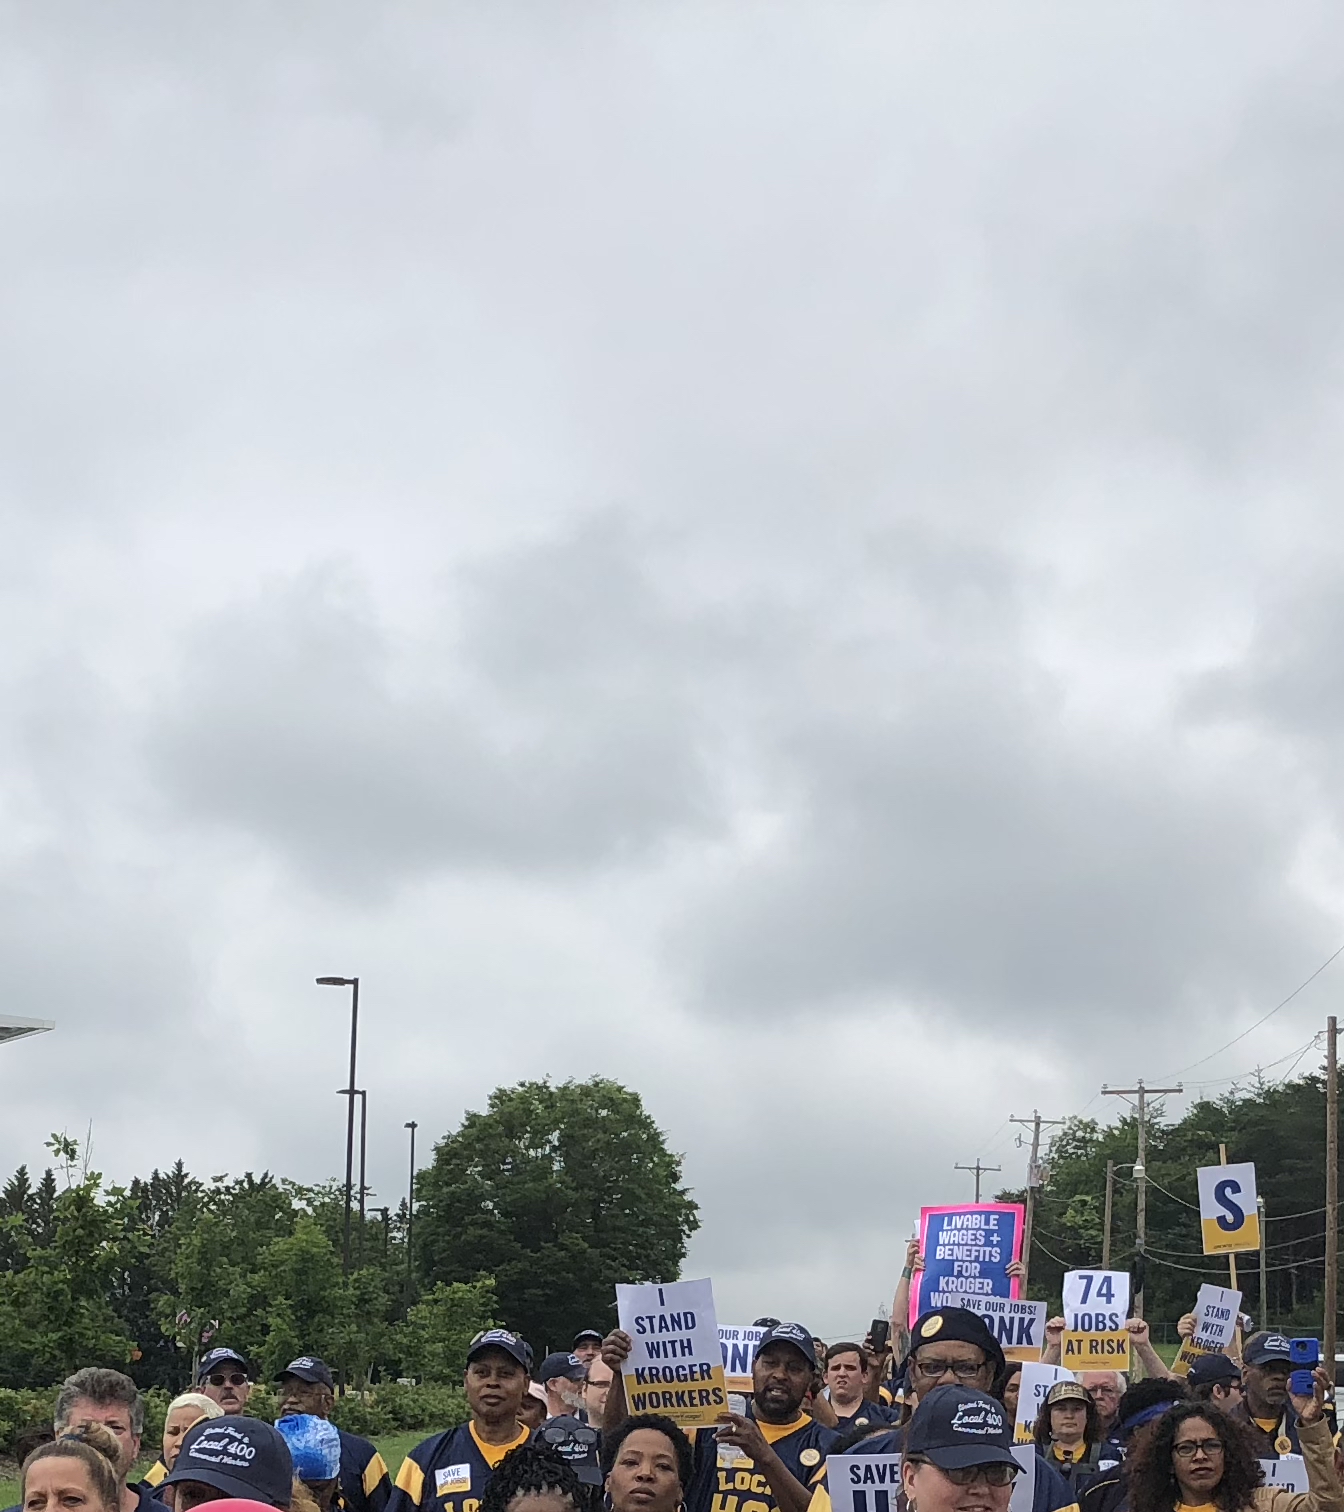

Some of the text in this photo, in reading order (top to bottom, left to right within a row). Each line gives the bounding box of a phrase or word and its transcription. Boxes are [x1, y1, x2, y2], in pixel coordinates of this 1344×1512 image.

[1214, 1179, 1245, 1231] S
[943, 1215, 999, 1230] LIVABLE
[938, 1230, 985, 1245] WAGES
[936, 1246, 1001, 1262] BENEFITS
[953, 1262, 980, 1277] FOR
[939, 1276, 993, 1294] KROGER
[1078, 1275, 1115, 1304] 74
[658, 1288, 665, 1306] I
[1219, 1291, 1224, 1302] I
[960, 1298, 982, 1311] SAVE
[984, 1301, 1005, 1313] OUR
[1008, 1303, 1037, 1316] JOBS!
[1204, 1305, 1231, 1321] STAND
[634, 1311, 697, 1335] STAND
[979, 1314, 1037, 1346] ONK
[1072, 1313, 1119, 1332] JOBS
[1201, 1321, 1224, 1337] WITH
[742, 1331, 763, 1341] JOB
[645, 1338, 694, 1359] WITH
[1065, 1339, 1126, 1355] AT RISK
[634, 1363, 713, 1385] KROGER
[1053, 1368, 1058, 1380] I
[631, 1387, 724, 1412] WORKERS
[951, 1411, 985, 1424] Local
[190, 1436, 255, 1459] Local 400
[442, 1467, 461, 1480] SAVE
[849, 1463, 901, 1484] SAVE
[1272, 1463, 1277, 1477] I
[717, 1471, 772, 1496] LOC
